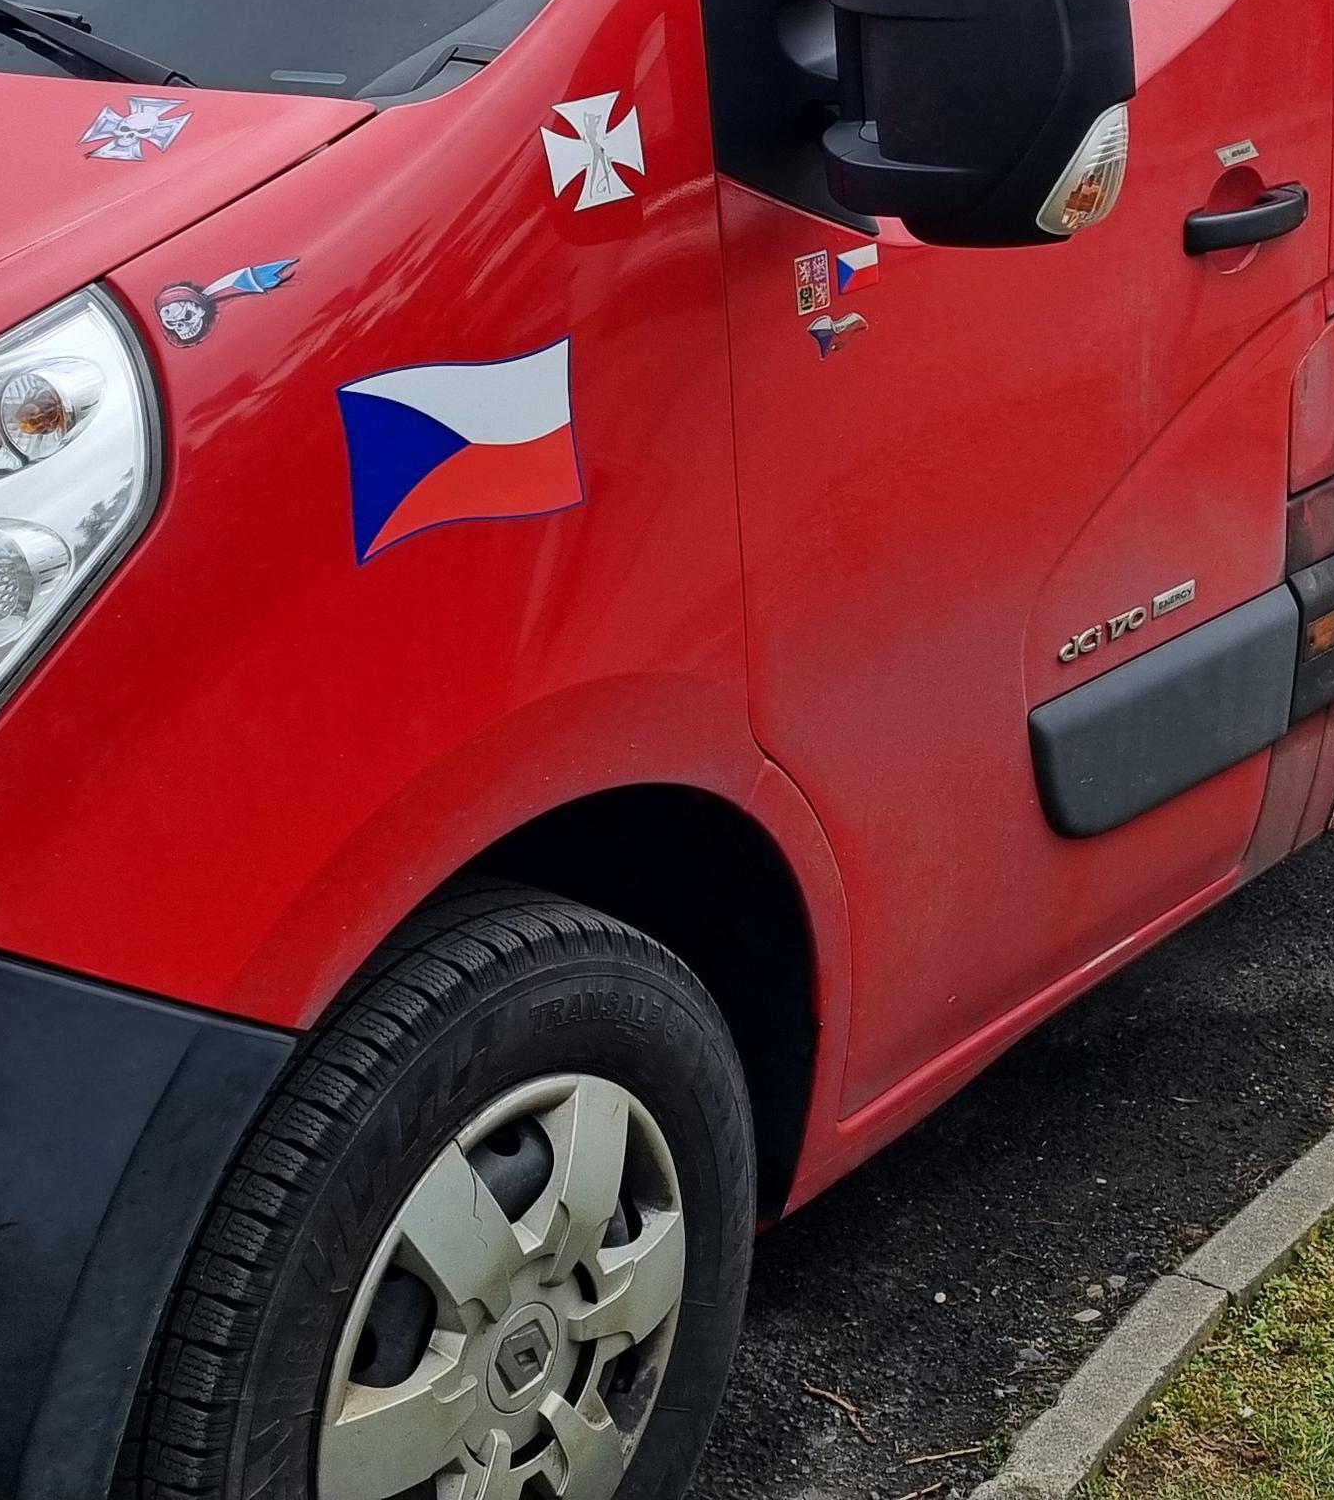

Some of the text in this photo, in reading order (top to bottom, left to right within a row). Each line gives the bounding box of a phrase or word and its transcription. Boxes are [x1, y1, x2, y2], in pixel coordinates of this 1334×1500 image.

[1106, 606, 1147, 641] 170
[1157, 586, 1194, 611] ENERGY
[529, 990, 664, 1036] TRANSALP
